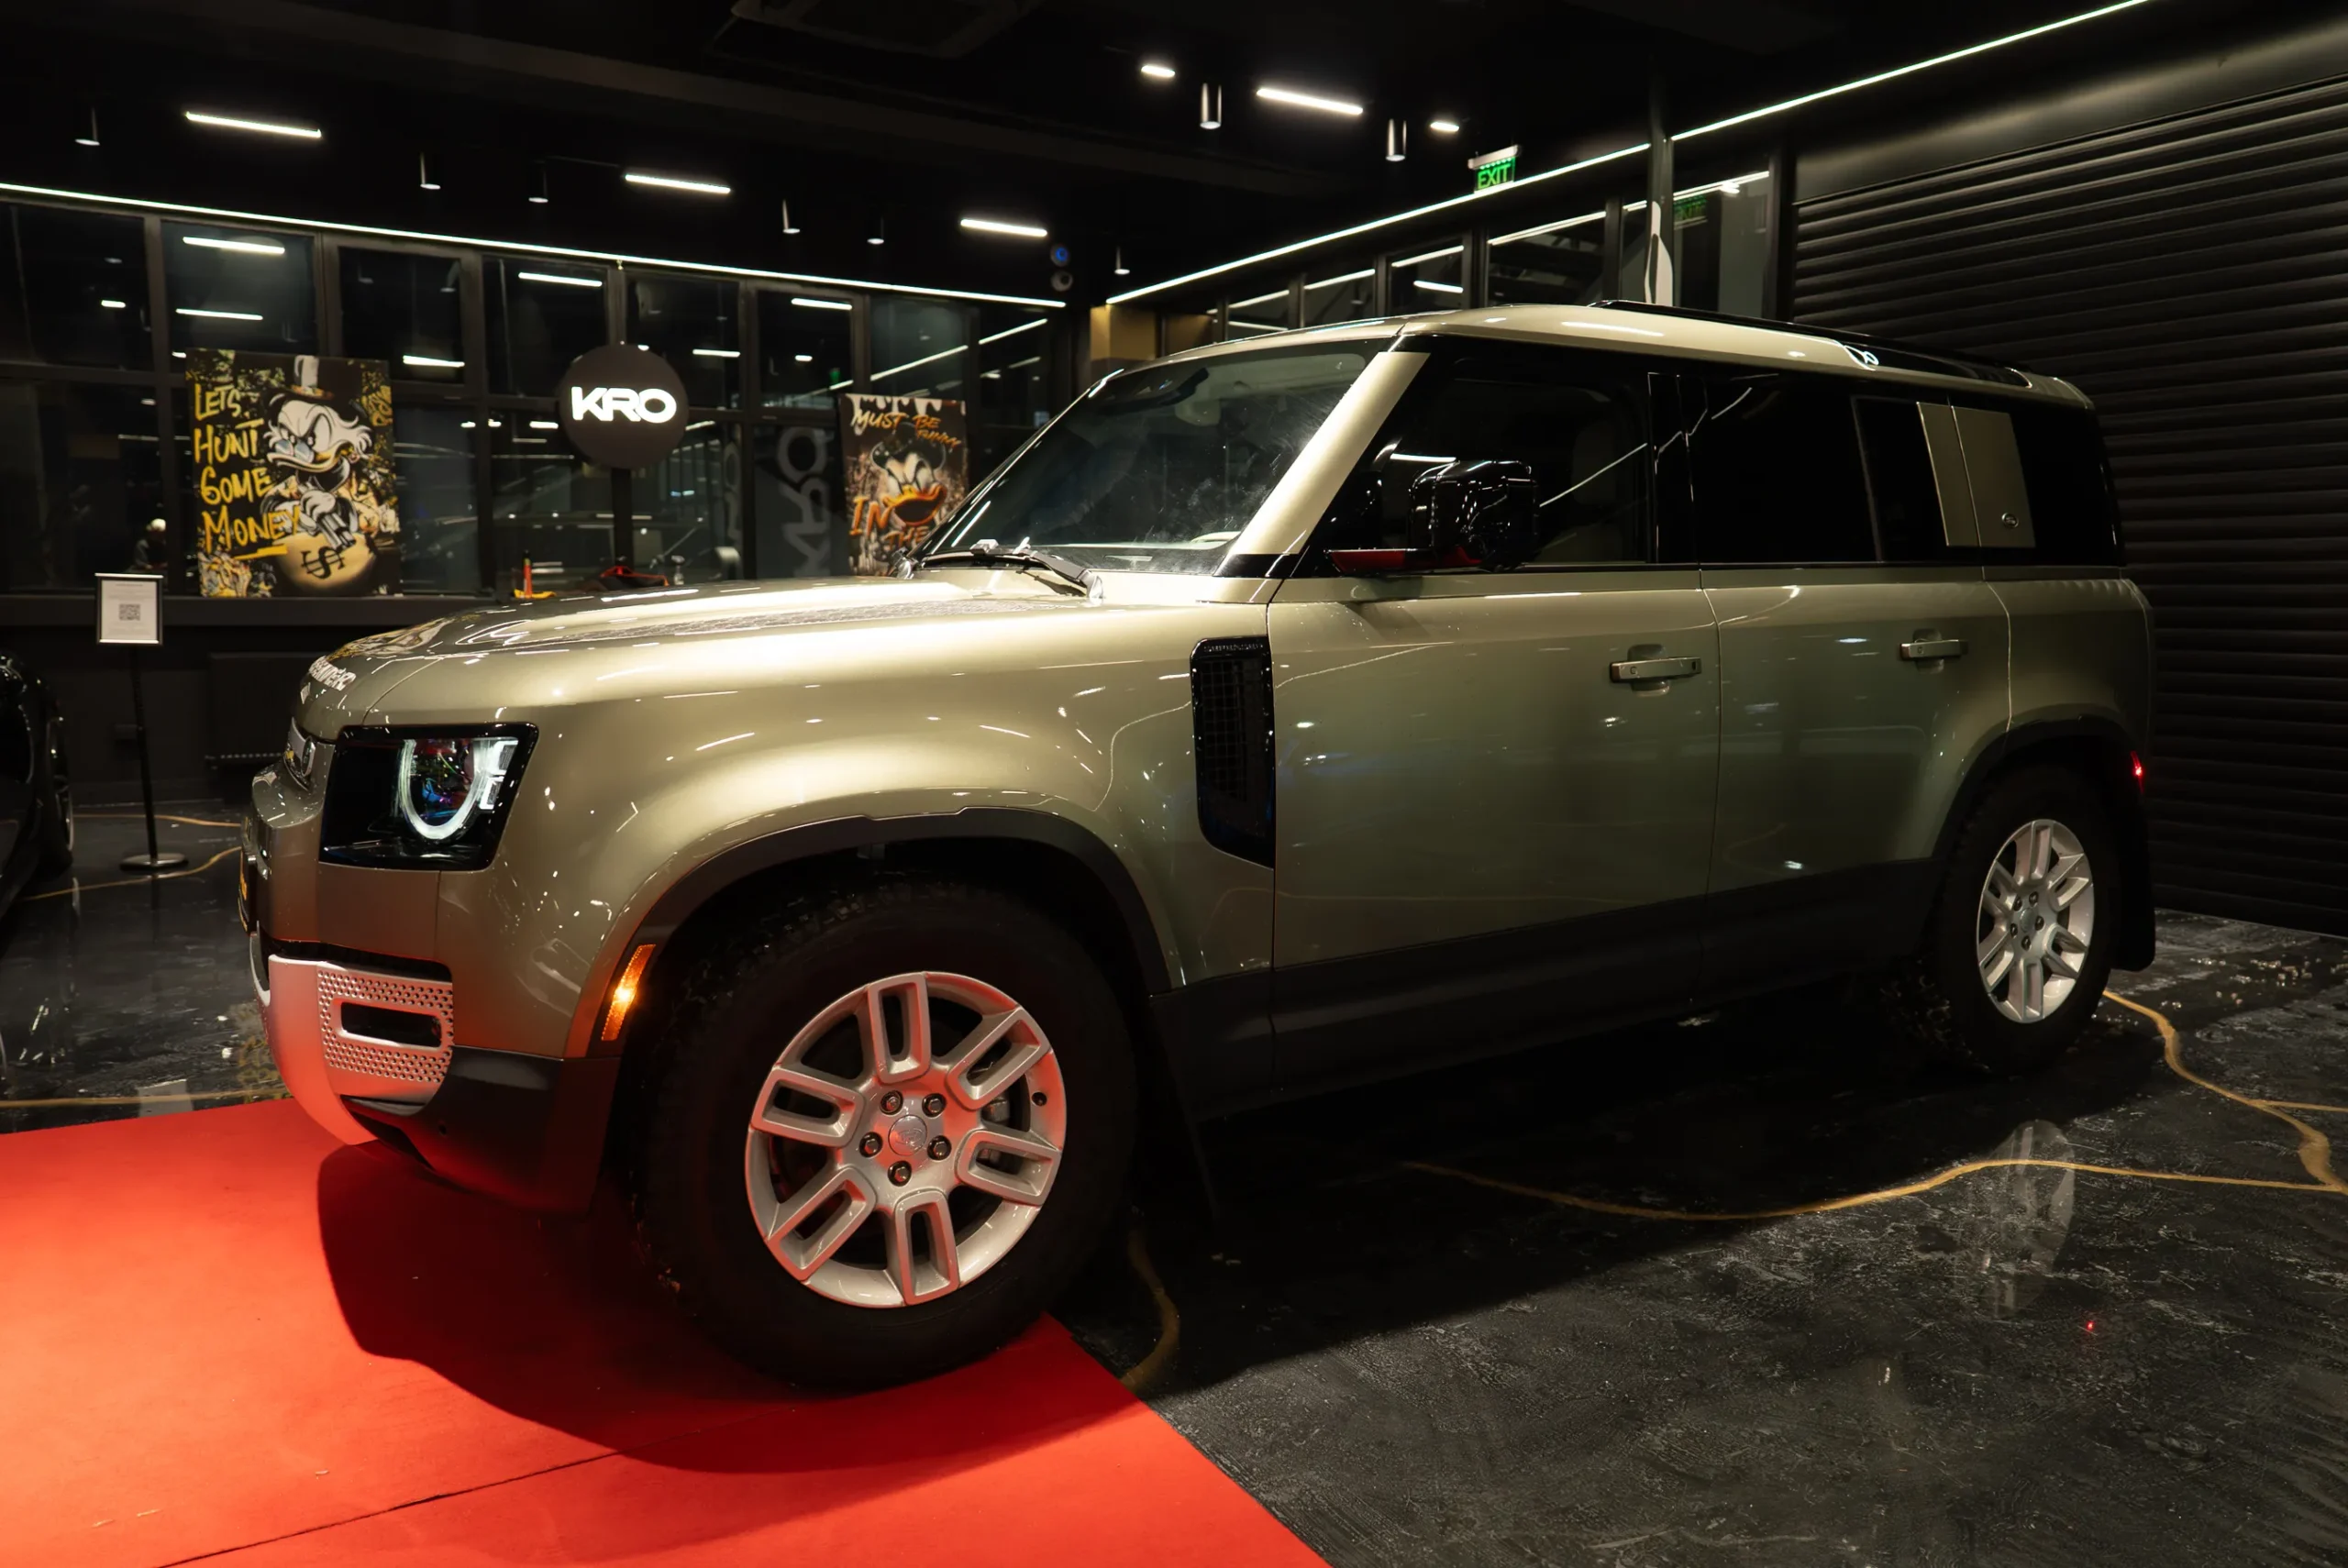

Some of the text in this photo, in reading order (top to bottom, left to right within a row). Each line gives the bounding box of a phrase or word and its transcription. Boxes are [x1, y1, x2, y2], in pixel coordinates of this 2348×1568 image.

[1478, 163, 1512, 190] EXIT
[571, 386, 677, 423] KRO
[850, 410, 941, 429] MUST BE
[194, 418, 264, 465] HUNT
[202, 504, 300, 554] MONEY
[849, 496, 893, 536] IN
[880, 525, 930, 550] THE
